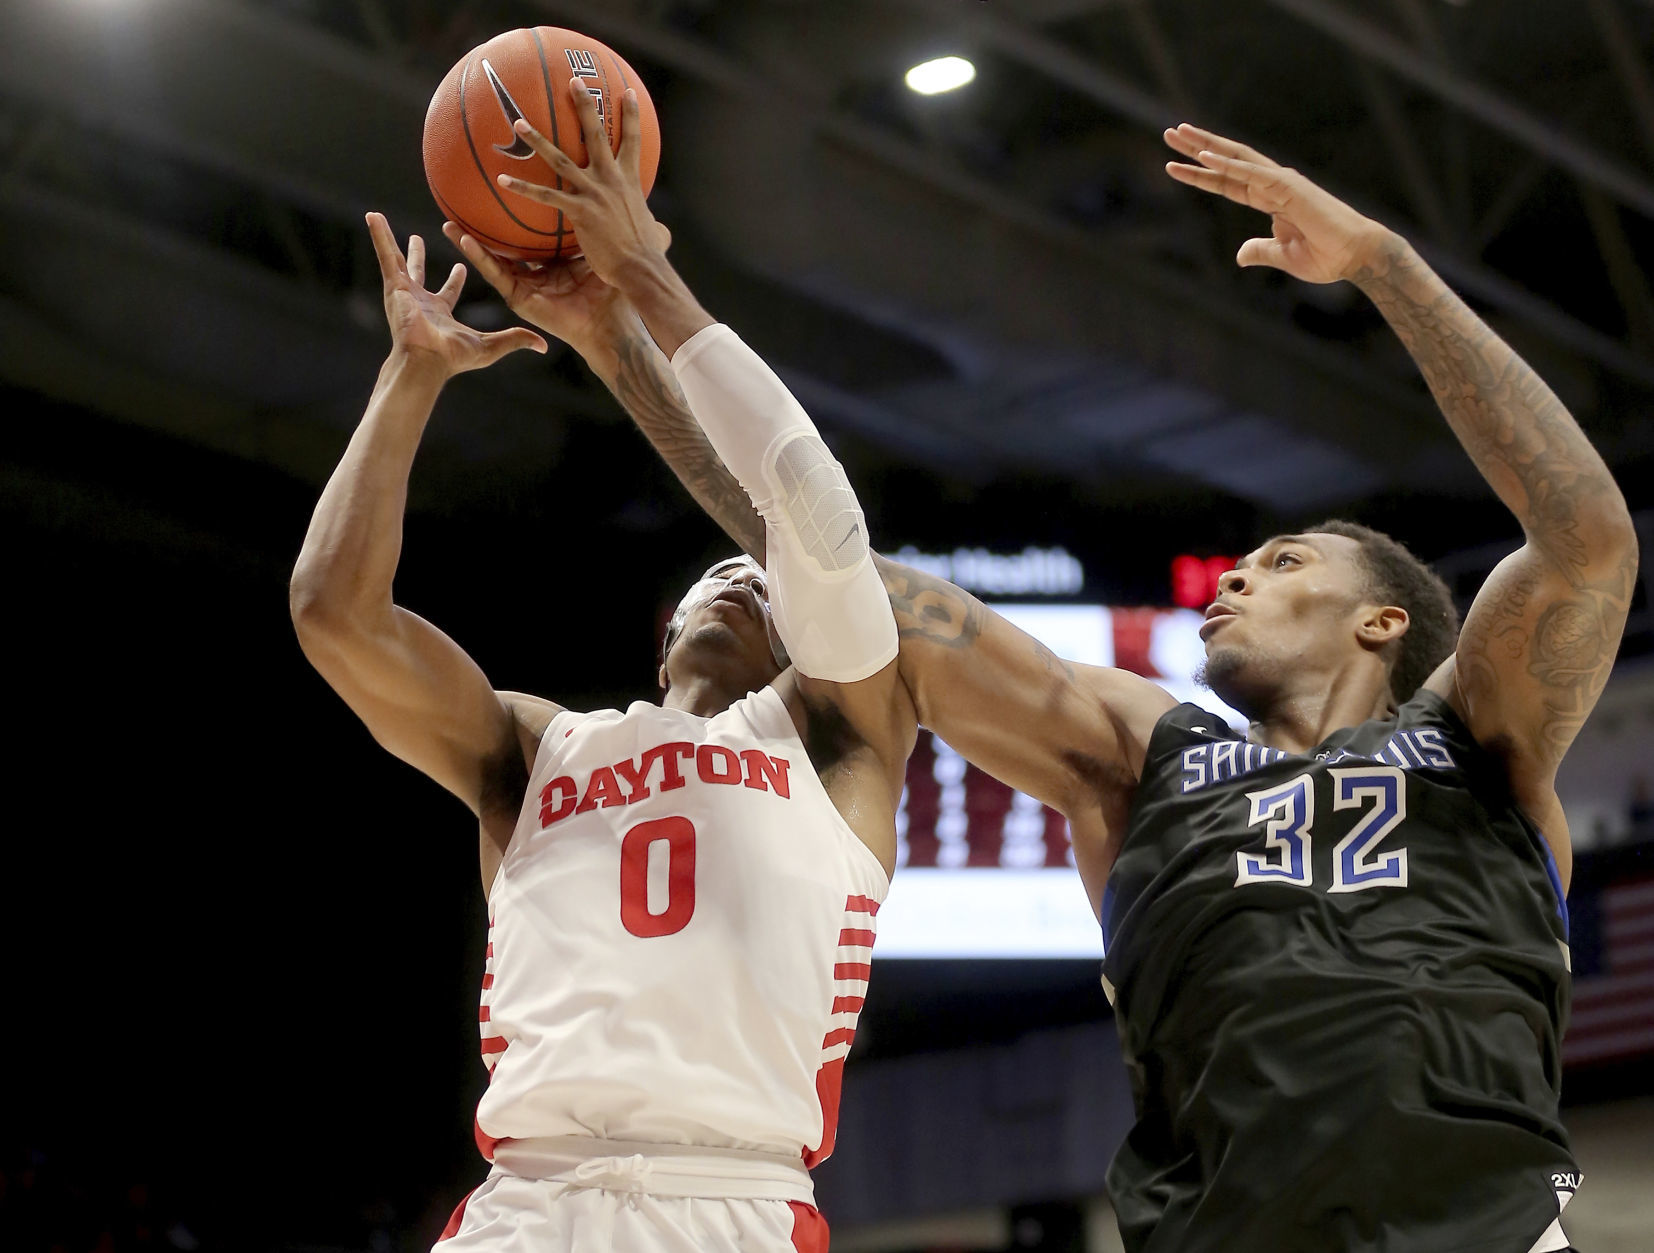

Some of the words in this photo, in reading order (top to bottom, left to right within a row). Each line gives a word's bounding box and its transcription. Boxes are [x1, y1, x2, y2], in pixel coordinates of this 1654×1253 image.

[539, 742, 790, 829] DAYTON
[1234, 767, 1408, 893] 32
[620, 815, 696, 938] 0
